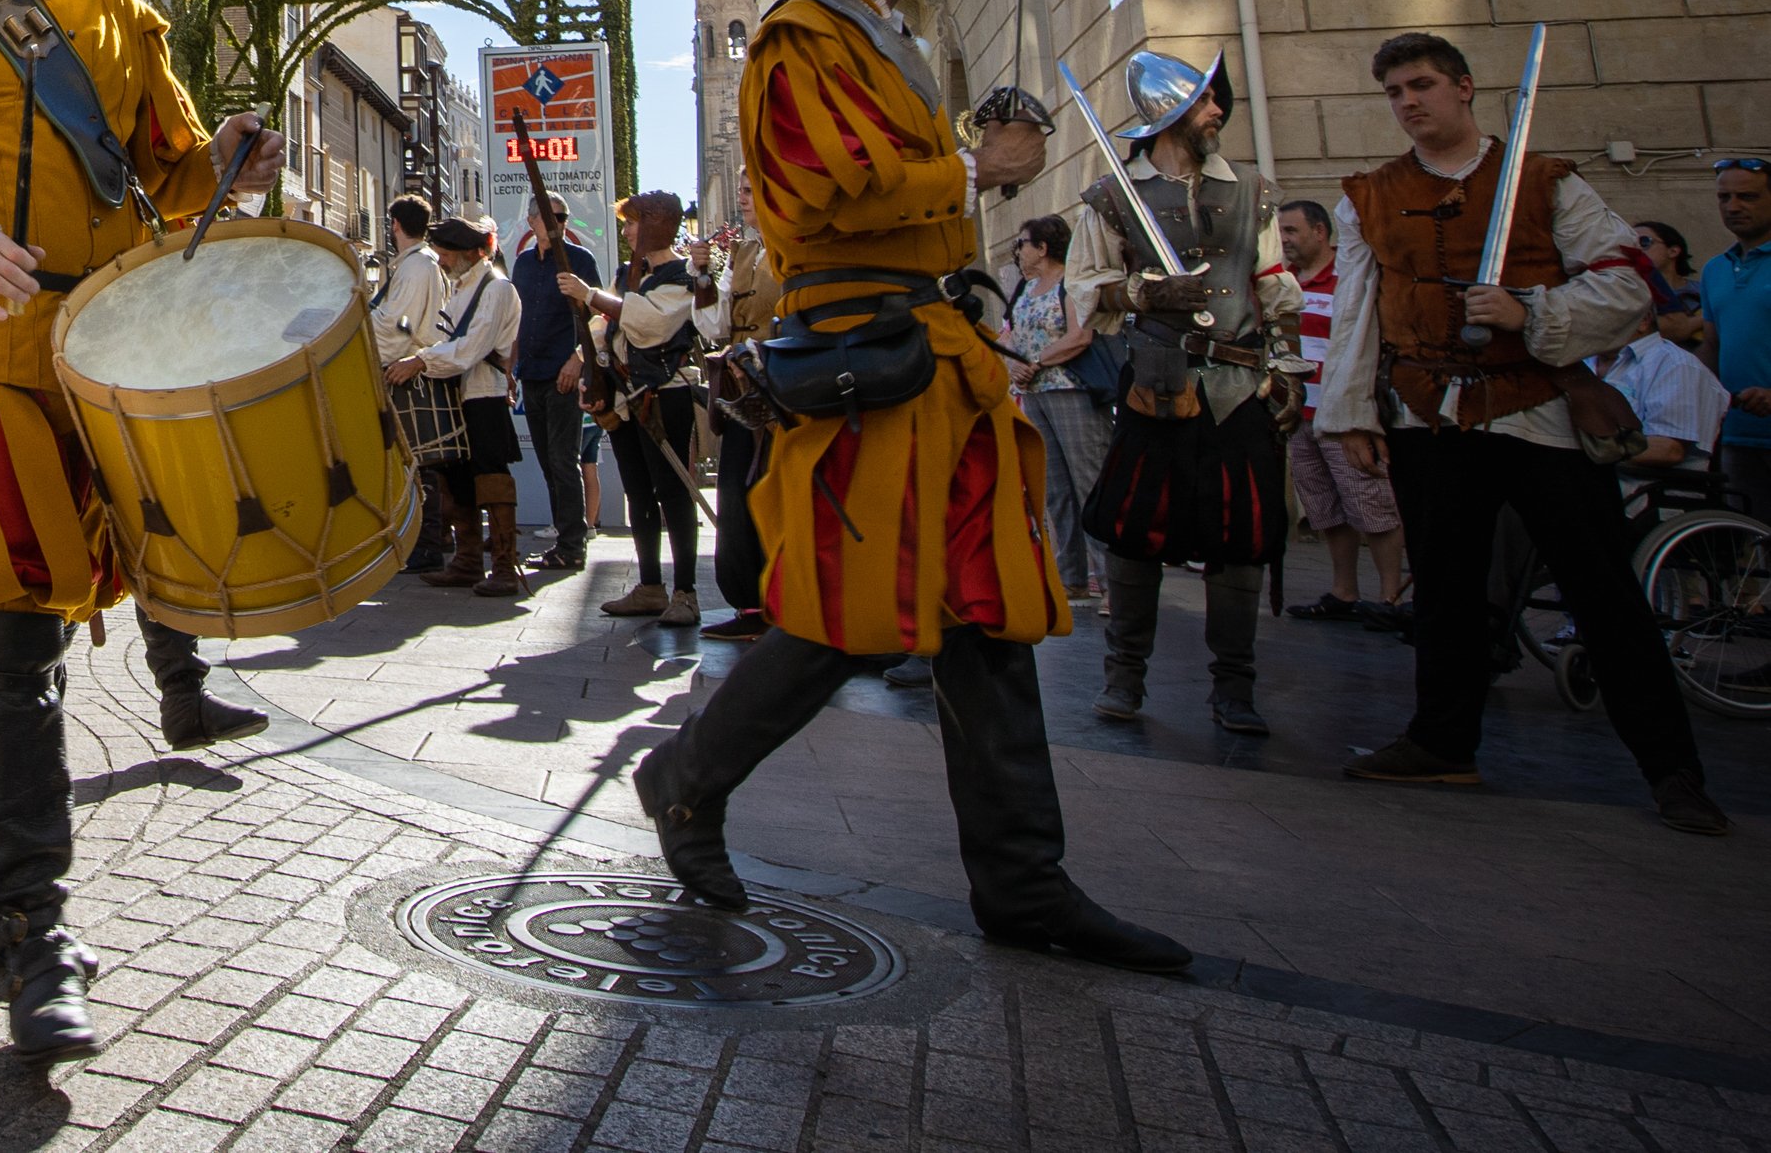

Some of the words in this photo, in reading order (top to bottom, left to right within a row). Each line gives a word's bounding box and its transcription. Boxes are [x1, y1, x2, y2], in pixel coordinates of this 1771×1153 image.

[530, 52, 593, 64] PEATONAL
[499, 121, 595, 132] PRTALES
[493, 173, 531, 183] CONTRO
[540, 169, 602, 181] AUTOMÁTICO
[494, 185, 529, 195] LECTOR
